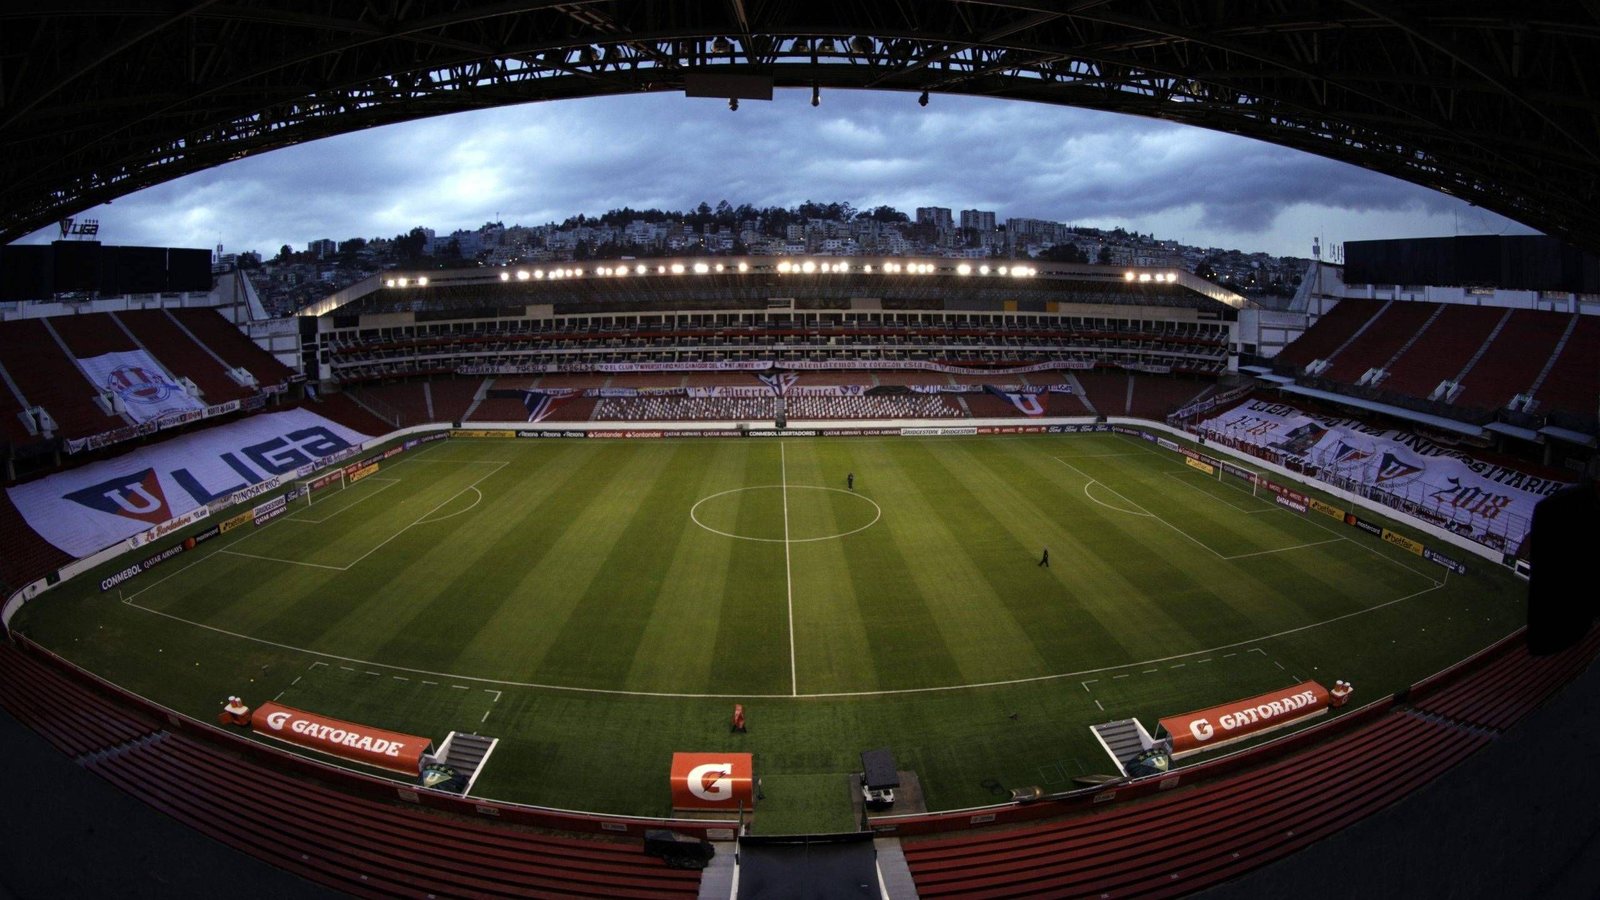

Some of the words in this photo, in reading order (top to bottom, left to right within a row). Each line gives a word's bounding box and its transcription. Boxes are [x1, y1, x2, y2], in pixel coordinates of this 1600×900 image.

[718, 386, 770, 398] Muerte
[788, 385, 837, 397] Blanca
[593, 431, 624, 439] Santander
[632, 431, 662, 439] Santander
[749, 430, 777, 438] CONMEBOL
[777, 430, 817, 438] LIBERTADORES
[1048, 425, 1062, 433] Ford
[1064, 425, 1078, 433] Ford
[1080, 424, 1094, 432] Ford
[1096, 424, 1110, 432] Ford
[233, 476, 282, 505] DINOSARIOS
[103, 482, 163, 514] U
[1429, 477, 1513, 520] 2018
[255, 512, 270, 526] QATAR
[1390, 534, 1413, 549] betfair
[101, 564, 142, 591] CONMEBOL
[143, 555, 163, 571] QATAR
[161, 544, 184, 562] AIRWAYS
[1189, 718, 1214, 741] G
[1219, 690, 1318, 731] GATORADE
[267, 710, 292, 731] G
[292, 719, 405, 757] GATORADE
[686, 762, 734, 802] G
